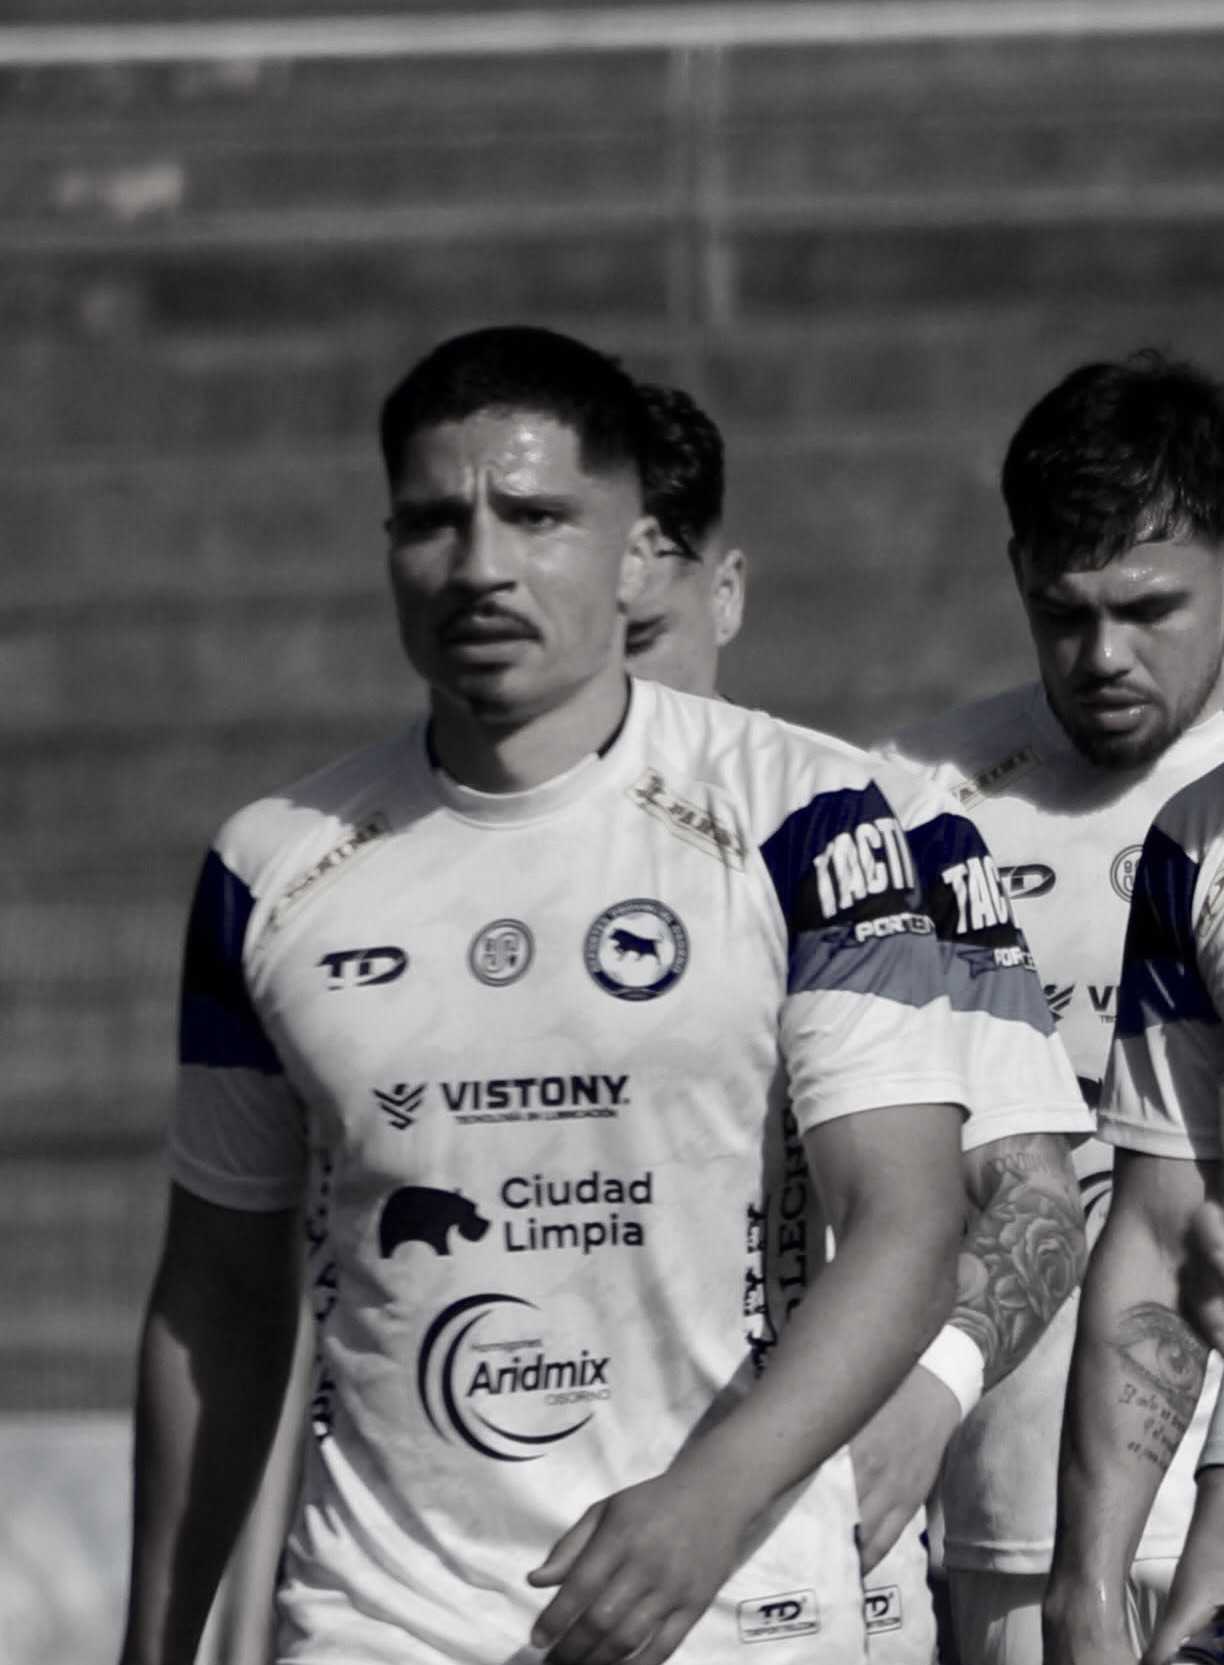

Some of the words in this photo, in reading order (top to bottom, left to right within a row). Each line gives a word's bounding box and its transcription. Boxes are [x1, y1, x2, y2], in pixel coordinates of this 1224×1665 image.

[998, 864, 1056, 900] D
[316, 946, 408, 990] TD
[440, 1075, 630, 1111] VISTONY
[502, 1172, 653, 1209] Ciudad
[505, 1215, 644, 1254] Limpia
[466, 1349, 611, 1397] Aridmix
[866, 1593, 890, 1618] D
